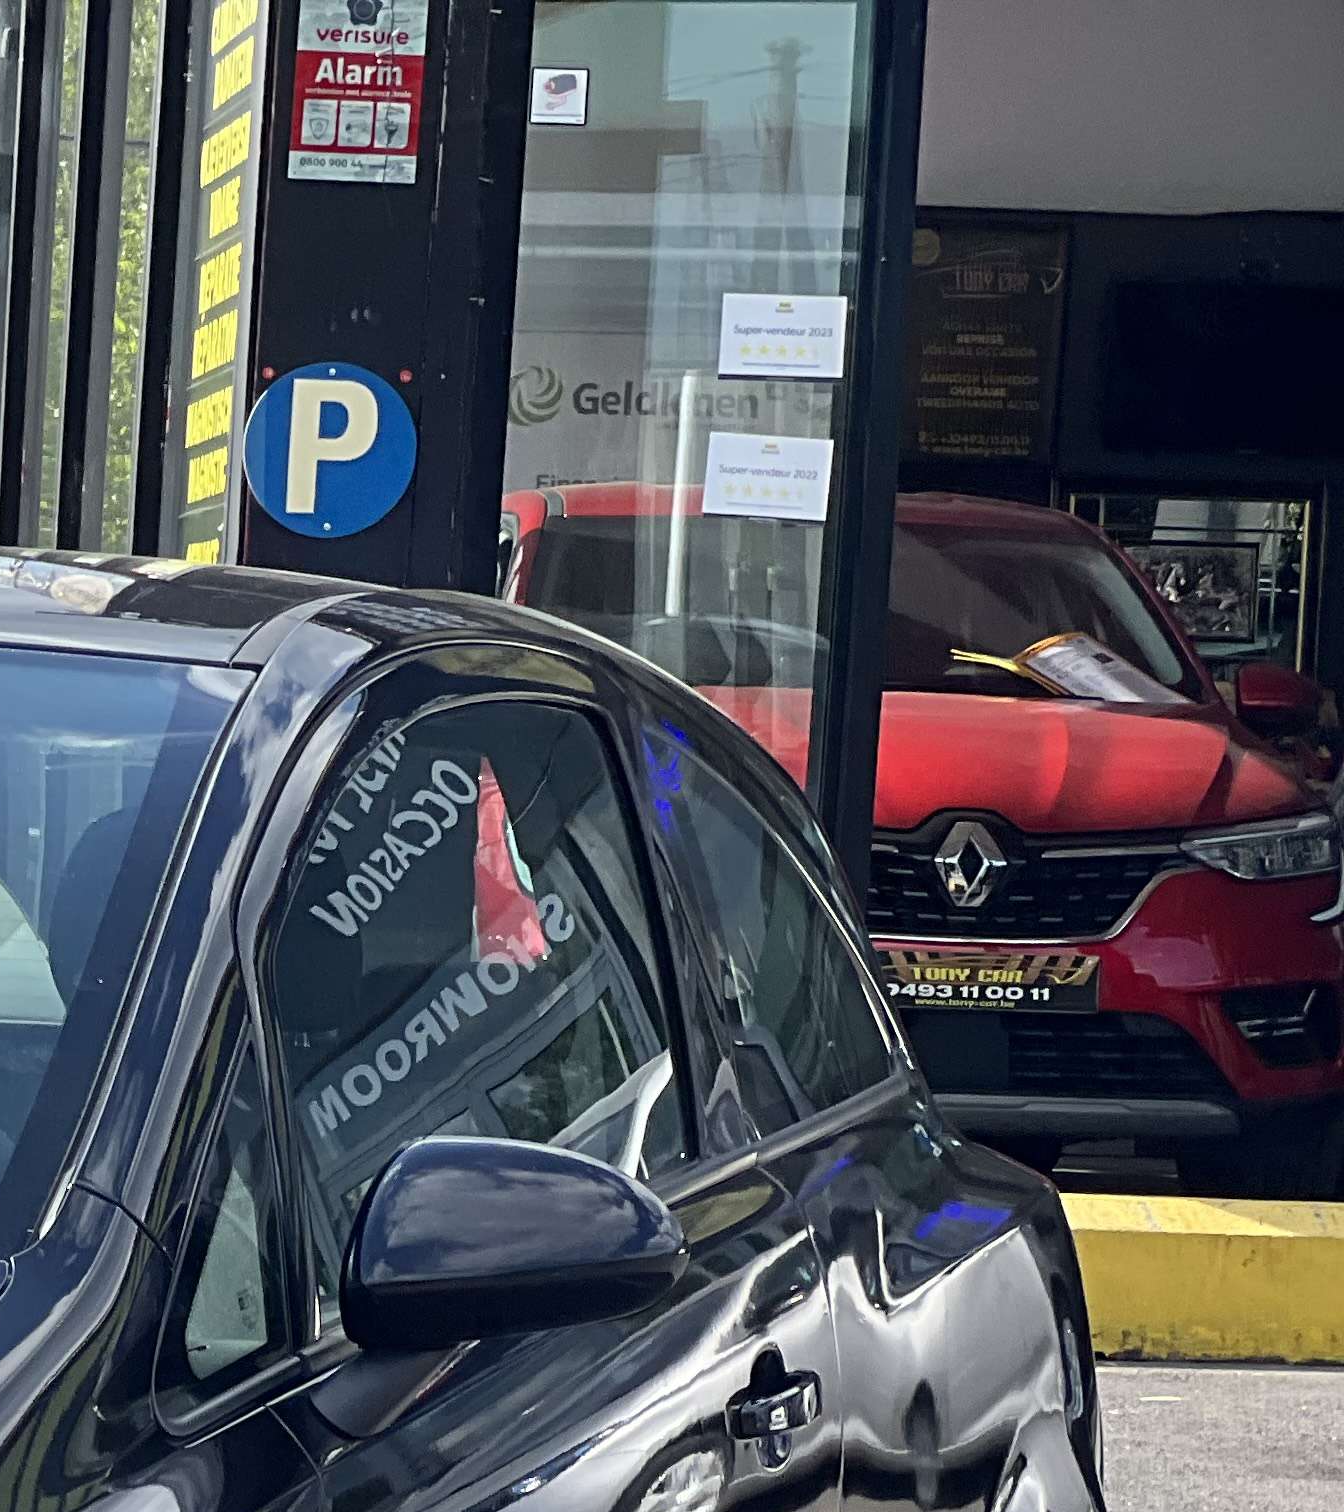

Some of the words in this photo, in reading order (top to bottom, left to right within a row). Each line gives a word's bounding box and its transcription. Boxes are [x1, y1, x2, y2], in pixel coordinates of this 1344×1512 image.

[316, 27, 409, 45] verisure
[315, 57, 403, 87] Alarm
[733, 324, 806, 338] Super-vendeur
[808, 326, 833, 338] 2023
[285, 378, 380, 515] P
[719, 464, 791, 478] Super-vendeur
[912, 966, 971, 982] TONY
[977, 968, 1024, 983] CAR
[959, 983, 979, 998] 11
[985, 984, 1024, 999] 00
[1029, 987, 1050, 1001] 11
